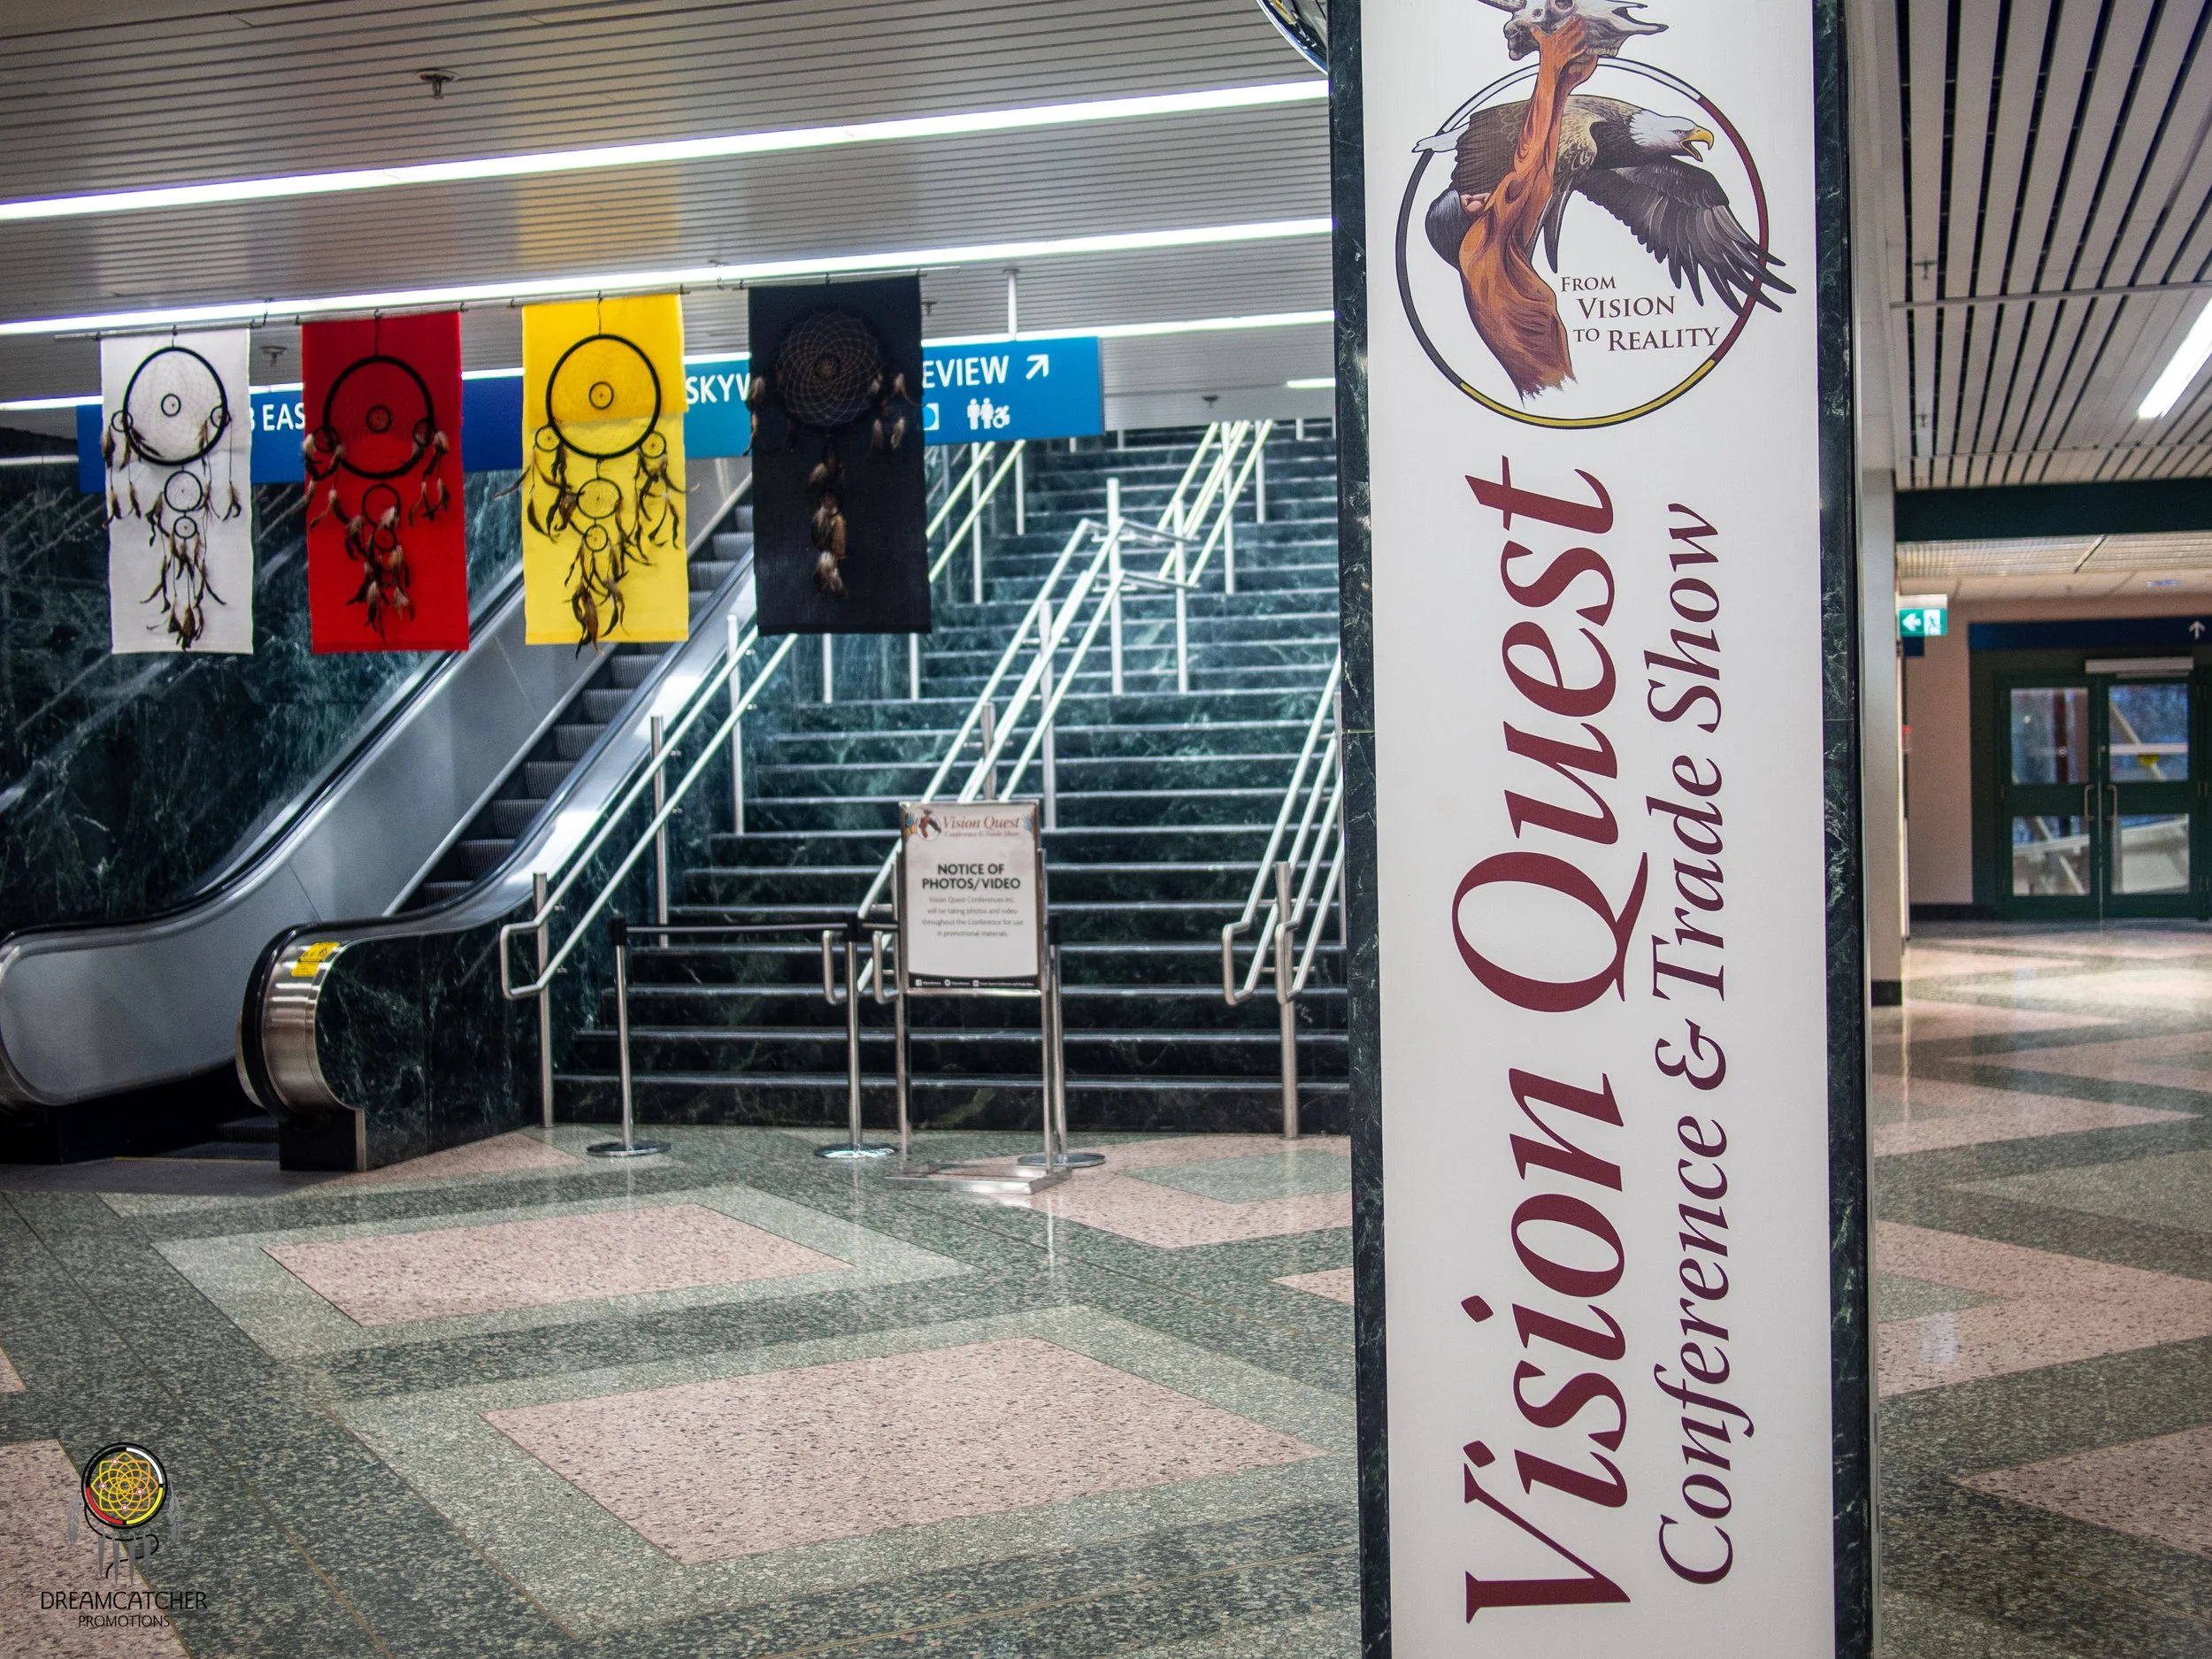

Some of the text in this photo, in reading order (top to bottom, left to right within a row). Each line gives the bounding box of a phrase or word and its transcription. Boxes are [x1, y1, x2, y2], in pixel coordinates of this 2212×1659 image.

[1561, 276, 1617, 293] FROM
[1576, 296, 1676, 319] VISION
[1608, 326, 1720, 352] REALITY
[943, 815, 1020, 830] Vision Quest
[937, 863, 1005, 875] NOTICE OF
[921, 877, 1021, 892] PHOTOS/VIDEO
[948, 907, 964, 916] taking
[966, 907, 987, 916] photos
[1451, 455, 1647, 1624] Vision Quest
[1643, 503, 1755, 1586] Conference & Trade Show
